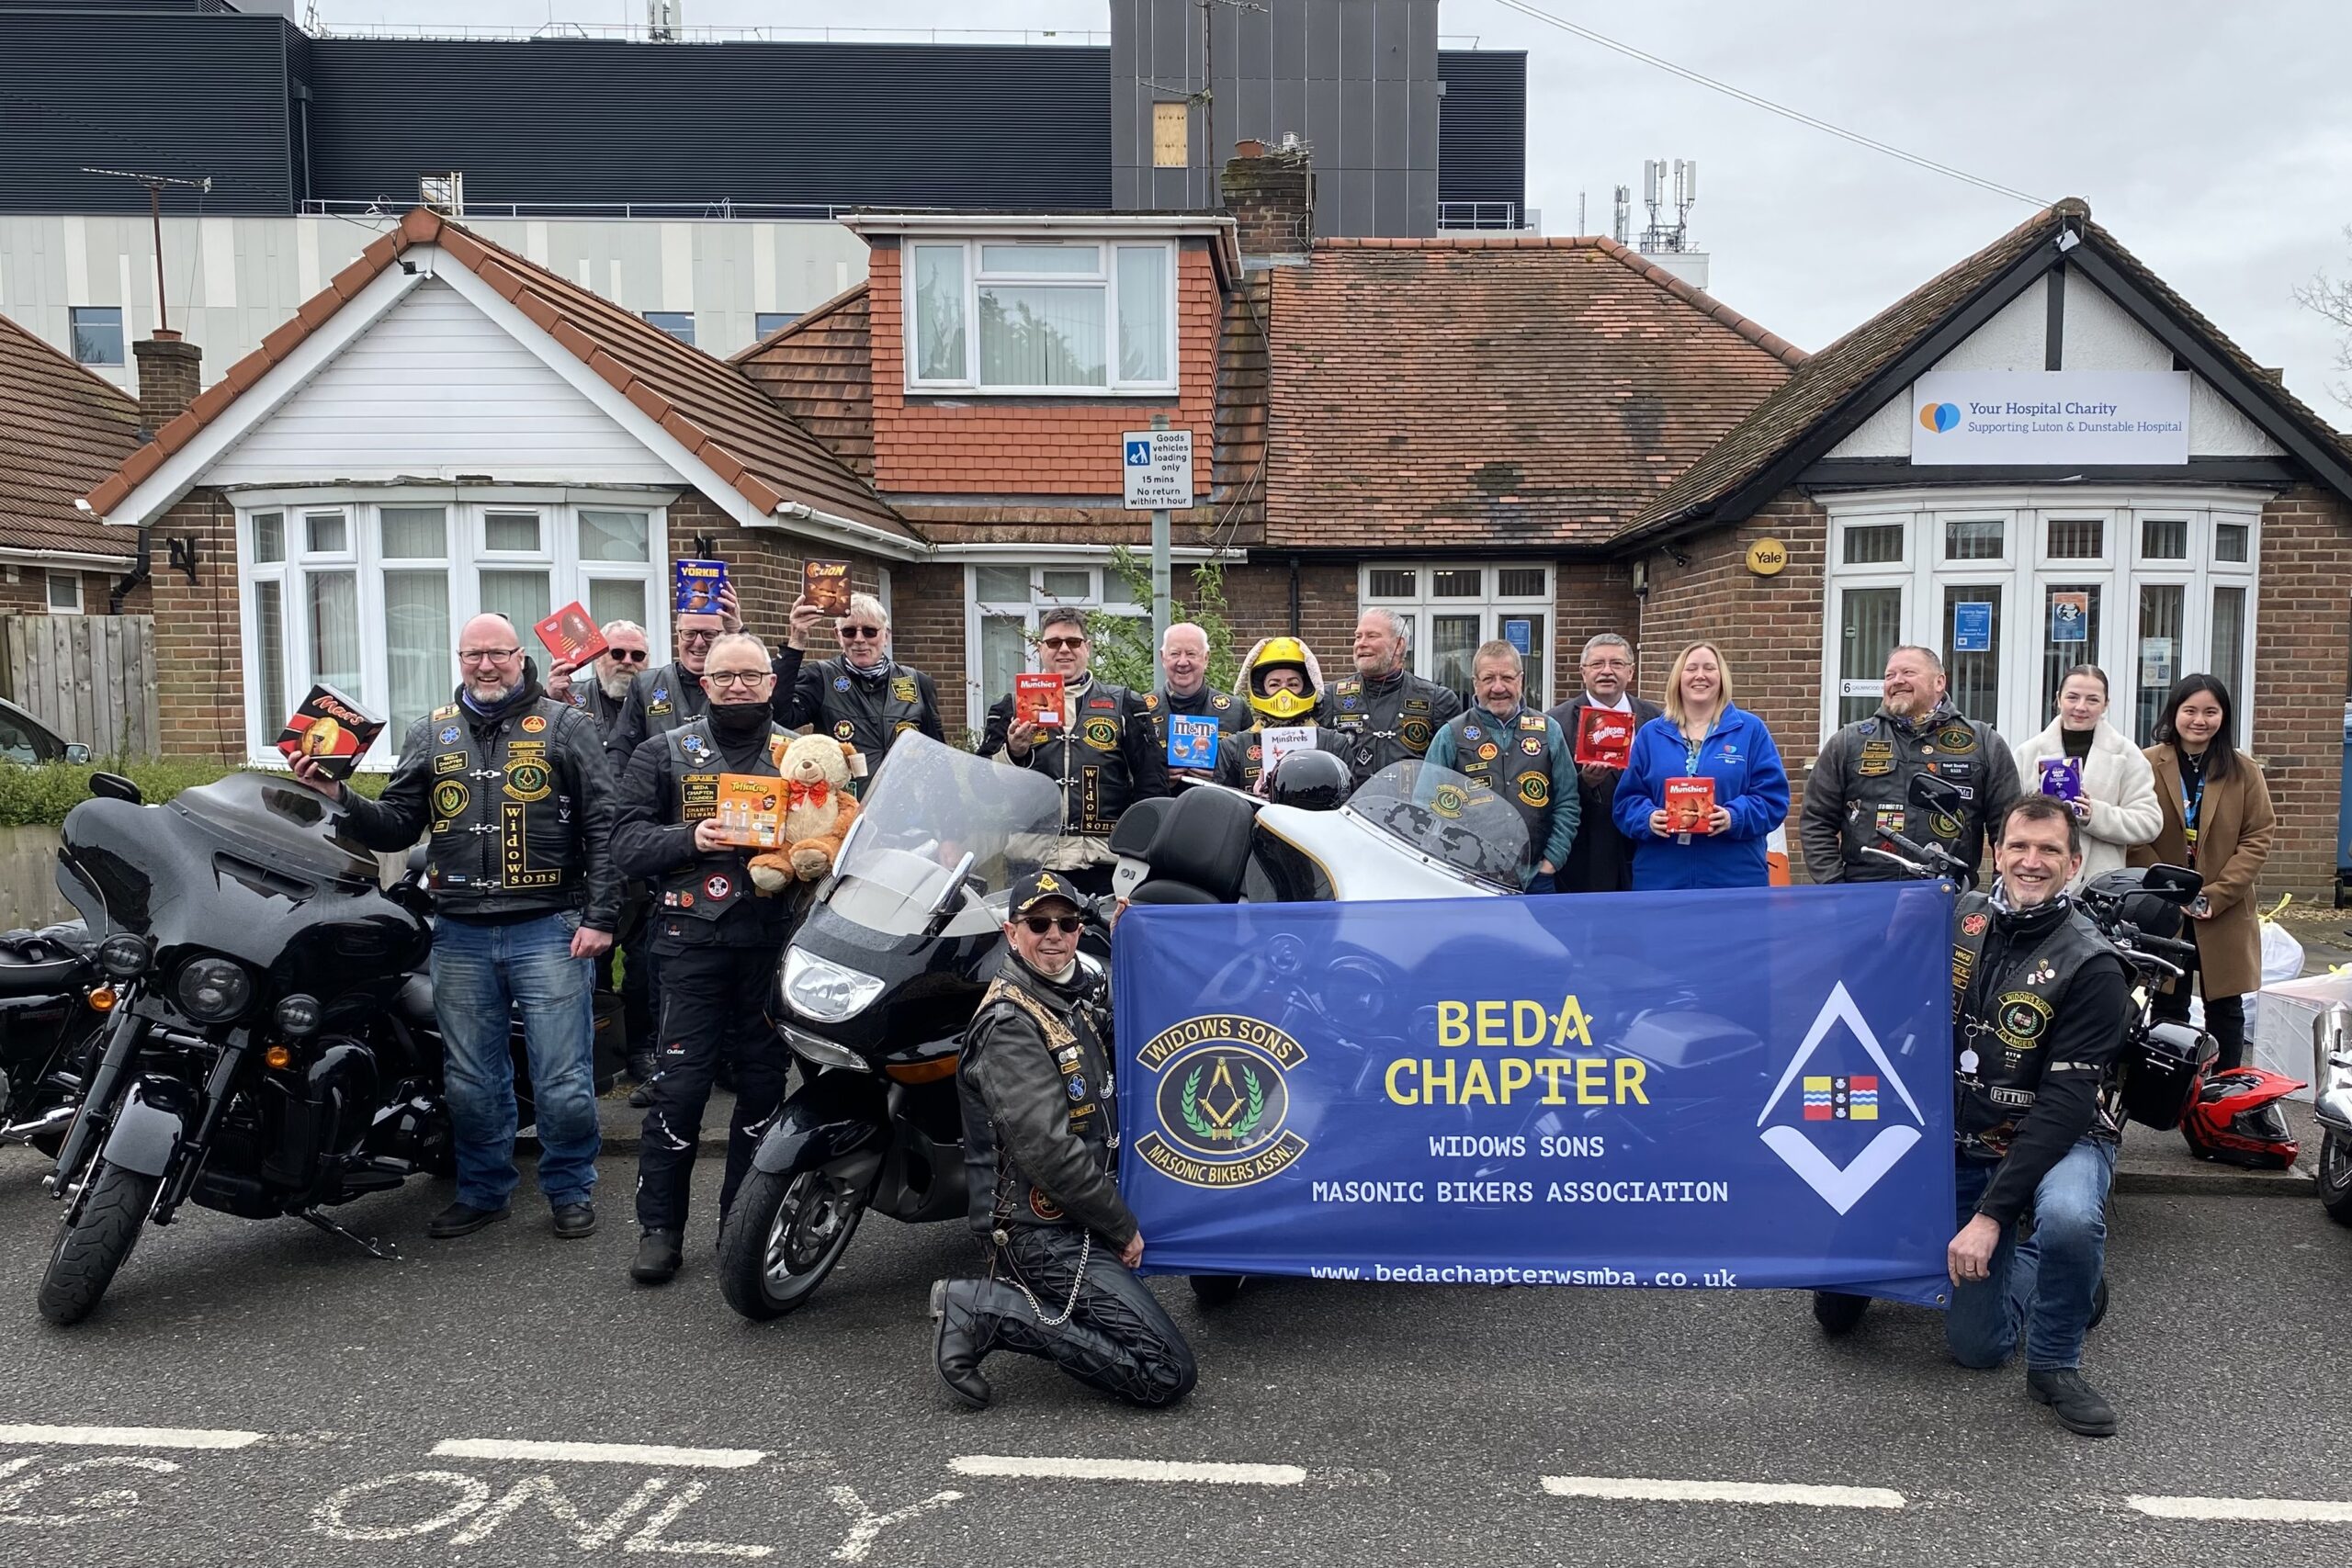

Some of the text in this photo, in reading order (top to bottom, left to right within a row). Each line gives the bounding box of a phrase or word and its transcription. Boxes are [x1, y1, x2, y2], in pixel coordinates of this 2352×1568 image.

[1970, 403, 2117, 417] Your Hospital Charity
[1968, 422, 2182, 434] Supporting Luton & Dunstable Hospital
[1156, 434, 1185, 442] Goods
[1154, 454, 1187, 462] loading
[1161, 463, 1180, 472] only
[1755, 552, 1782, 563] Yale
[681, 567, 719, 577] YORKIE
[1021, 680, 1057, 689] Munchies
[1844, 682, 1851, 693] 6
[312, 695, 364, 725] Mars
[1272, 735, 1308, 743] Minstrels
[1593, 726, 1626, 745] Maltesers
[511, 873, 556, 884] sons
[2005, 993, 2051, 1015] WIDOWS SONS
[1437, 995, 1593, 1047] BEDA
[1147, 1019, 1293, 1062] WIDOWS SONS
[2000, 1032, 2033, 1047] CLANGER
[1384, 1058, 1650, 1106] CHAPTER
[1429, 1135, 1605, 1157] WIDOWS SONS
[1147, 1145, 1294, 1183] MASONIC BIKERS ASSN.
[1312, 1181, 1728, 1202] MASONIC BIKERS ASSOCIATION
[1310, 1264, 1737, 1288] www.bedachapterwsmba.co.uk
[311, 1469, 963, 1563] ONLY
